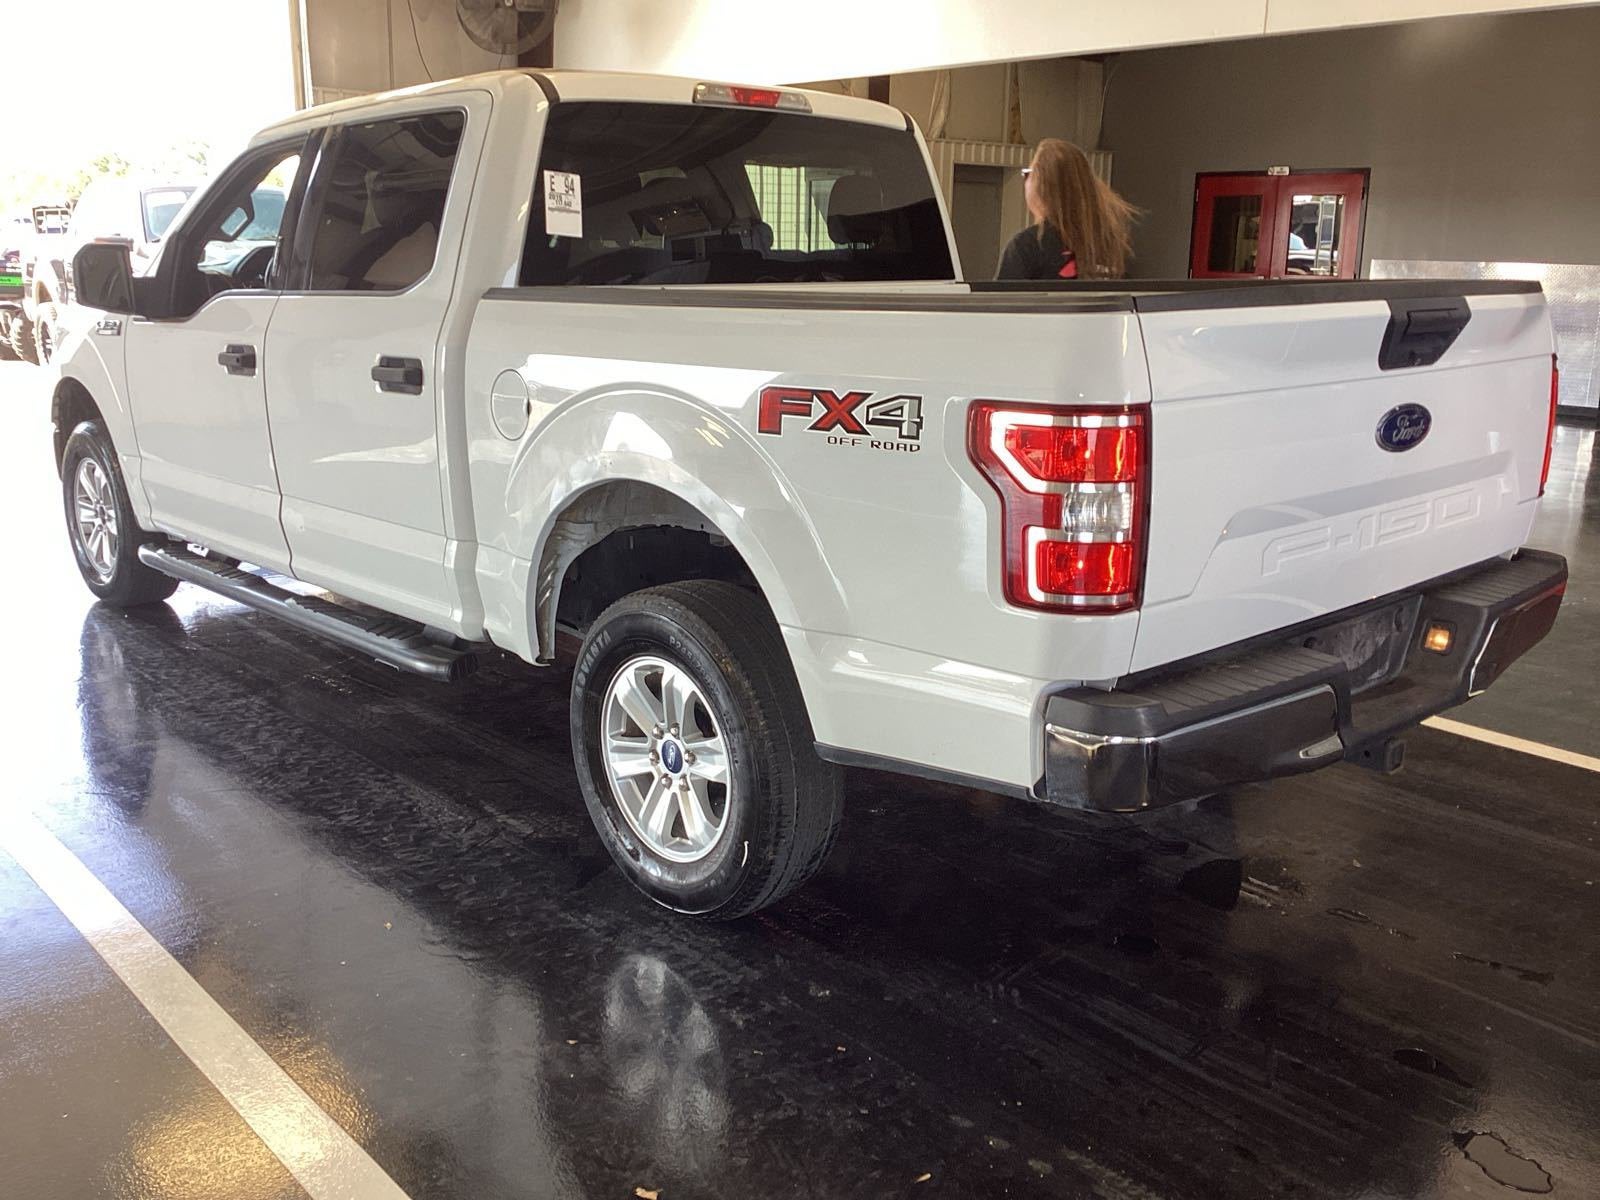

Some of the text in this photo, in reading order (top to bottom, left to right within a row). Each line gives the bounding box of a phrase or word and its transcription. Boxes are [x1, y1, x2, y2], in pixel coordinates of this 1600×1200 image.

[550, 175, 575, 194] E 94
[758, 386, 923, 440] FX4
[1392, 414, 1425, 442] Ford
[827, 436, 920, 452] OFF ROAD
[1261, 486, 1481, 577] F-150
